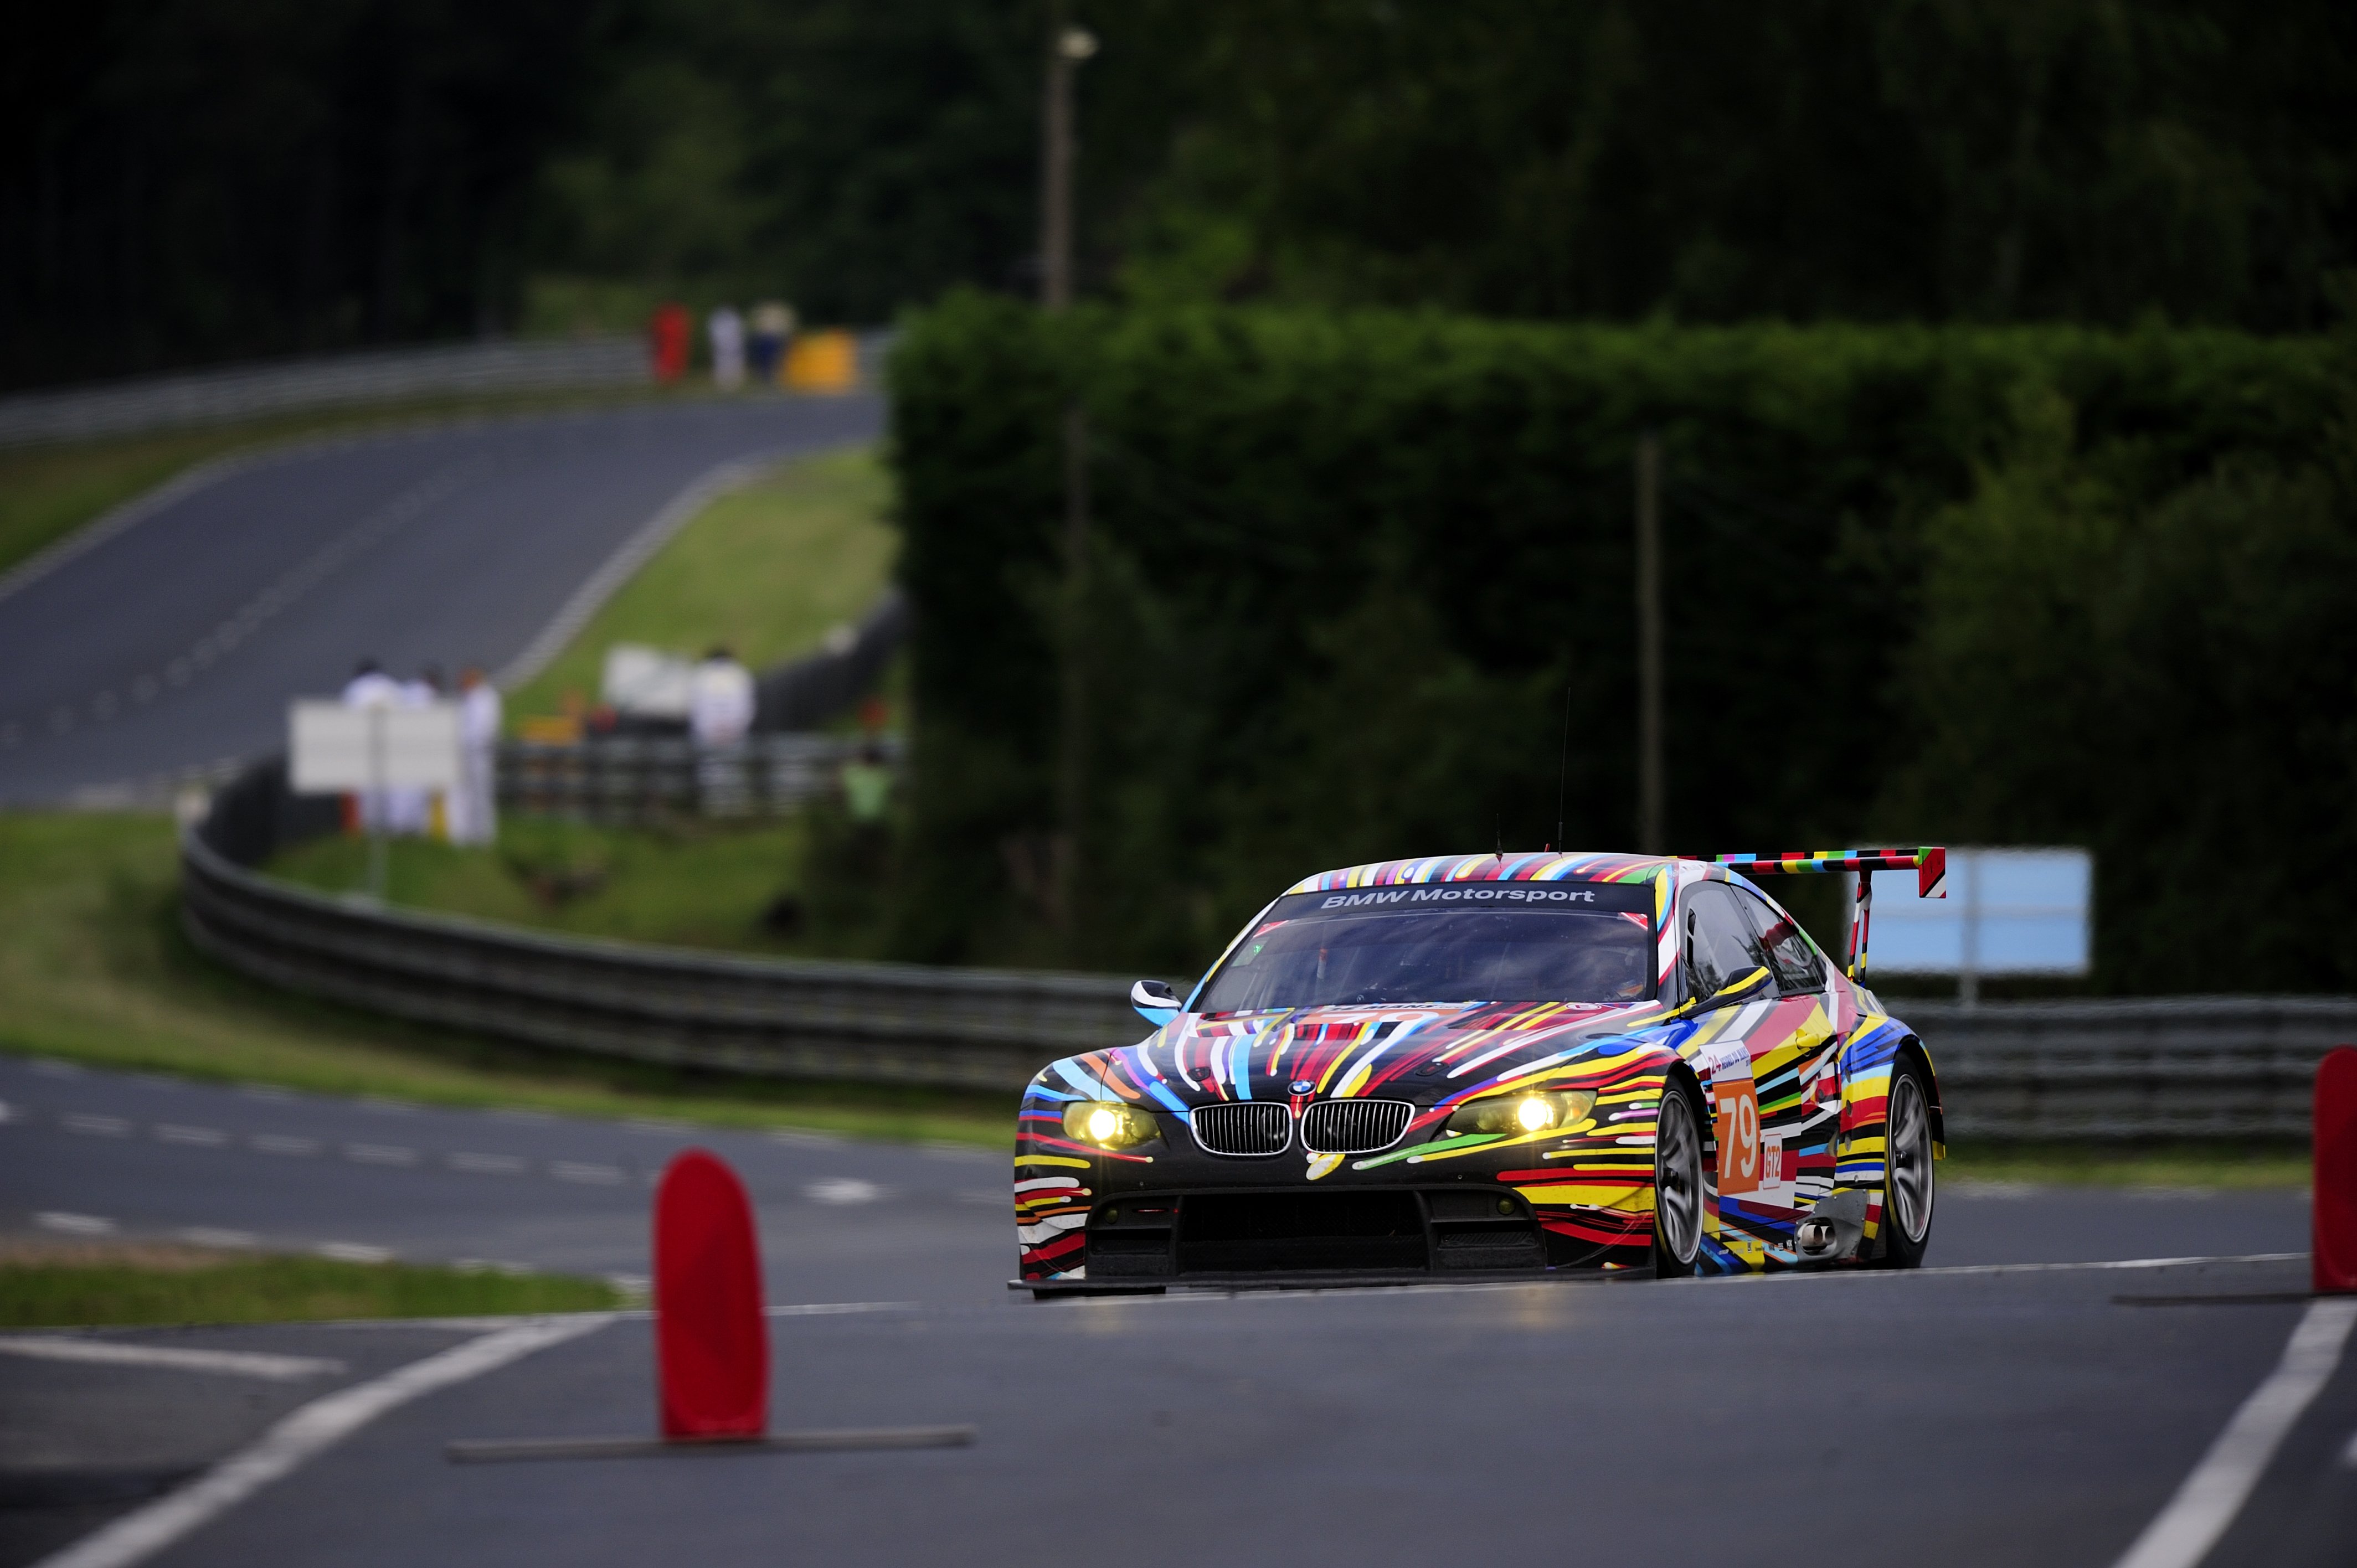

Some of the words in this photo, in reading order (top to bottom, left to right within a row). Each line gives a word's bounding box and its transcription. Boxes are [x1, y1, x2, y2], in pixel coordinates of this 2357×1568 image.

[1321, 891, 1409, 909] BMW
[1411, 889, 1595, 902] Motorsport
[1708, 1054, 1722, 1074] 24
[1720, 1094, 1757, 1178] 79
[1766, 1146, 1780, 1178] GT2
